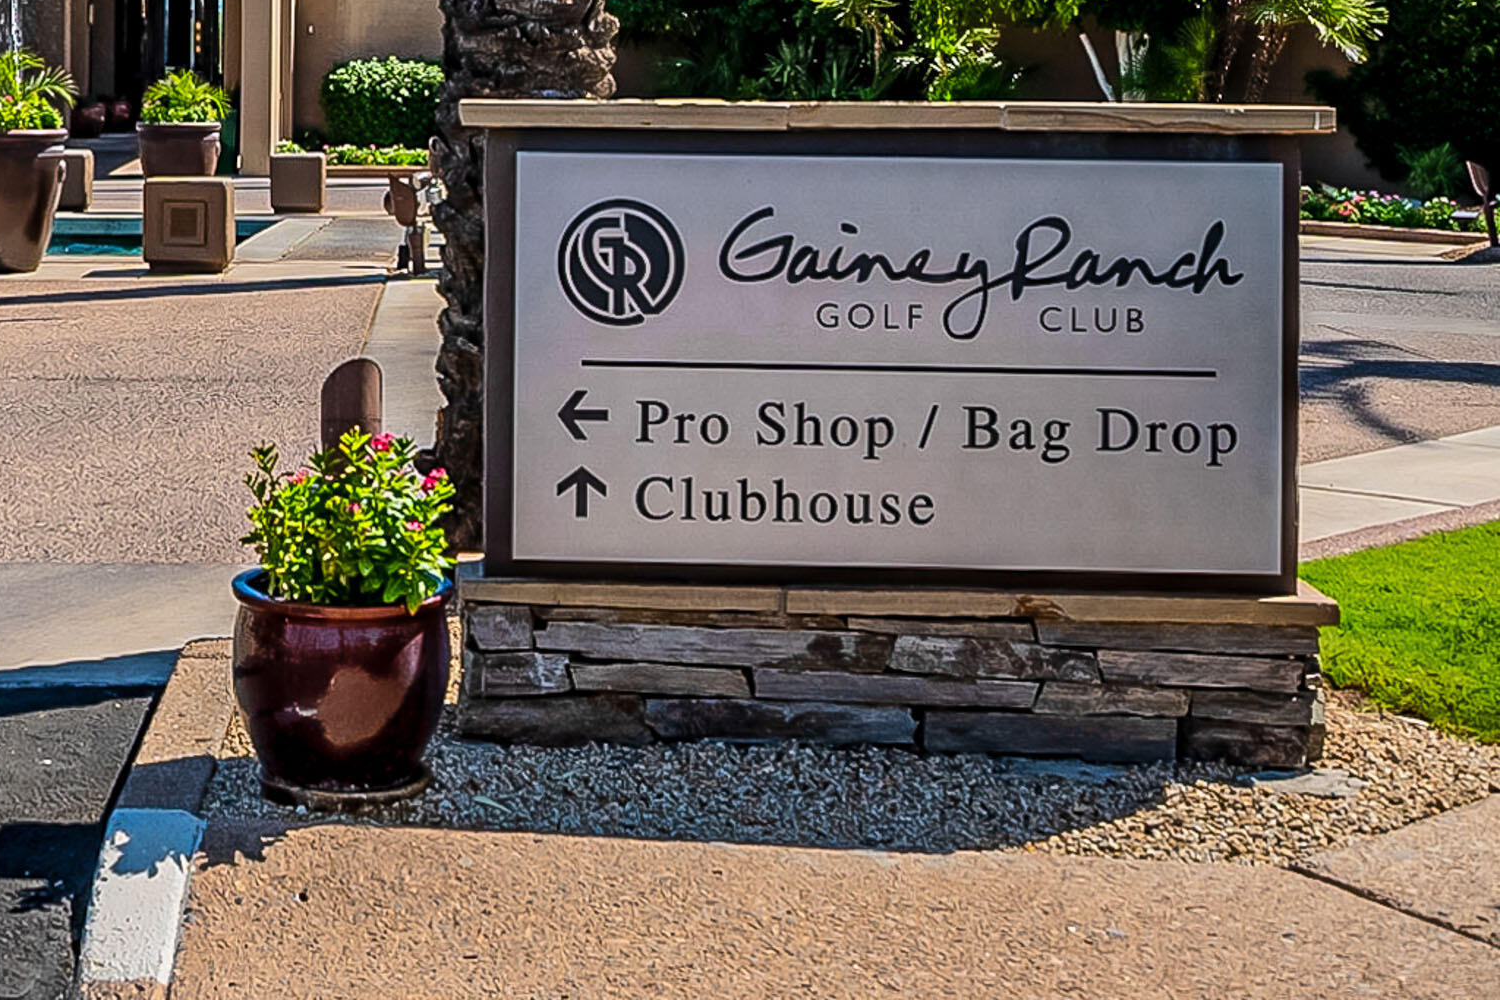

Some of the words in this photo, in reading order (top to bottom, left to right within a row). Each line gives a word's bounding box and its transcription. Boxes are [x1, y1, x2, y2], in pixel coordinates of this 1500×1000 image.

[719, 206, 988, 340] Gainey
[1011, 216, 1244, 301] Ranch
[816, 303, 923, 329] GOLF
[1040, 306, 1145, 333] CLUB
[635, 400, 729, 445] Pro
[756, 401, 895, 460] Shop
[918, 404, 939, 449] /
[961, 405, 1071, 464] Bag
[1096, 407, 1239, 466] Drop
[635, 475, 936, 526] Clubhouse
